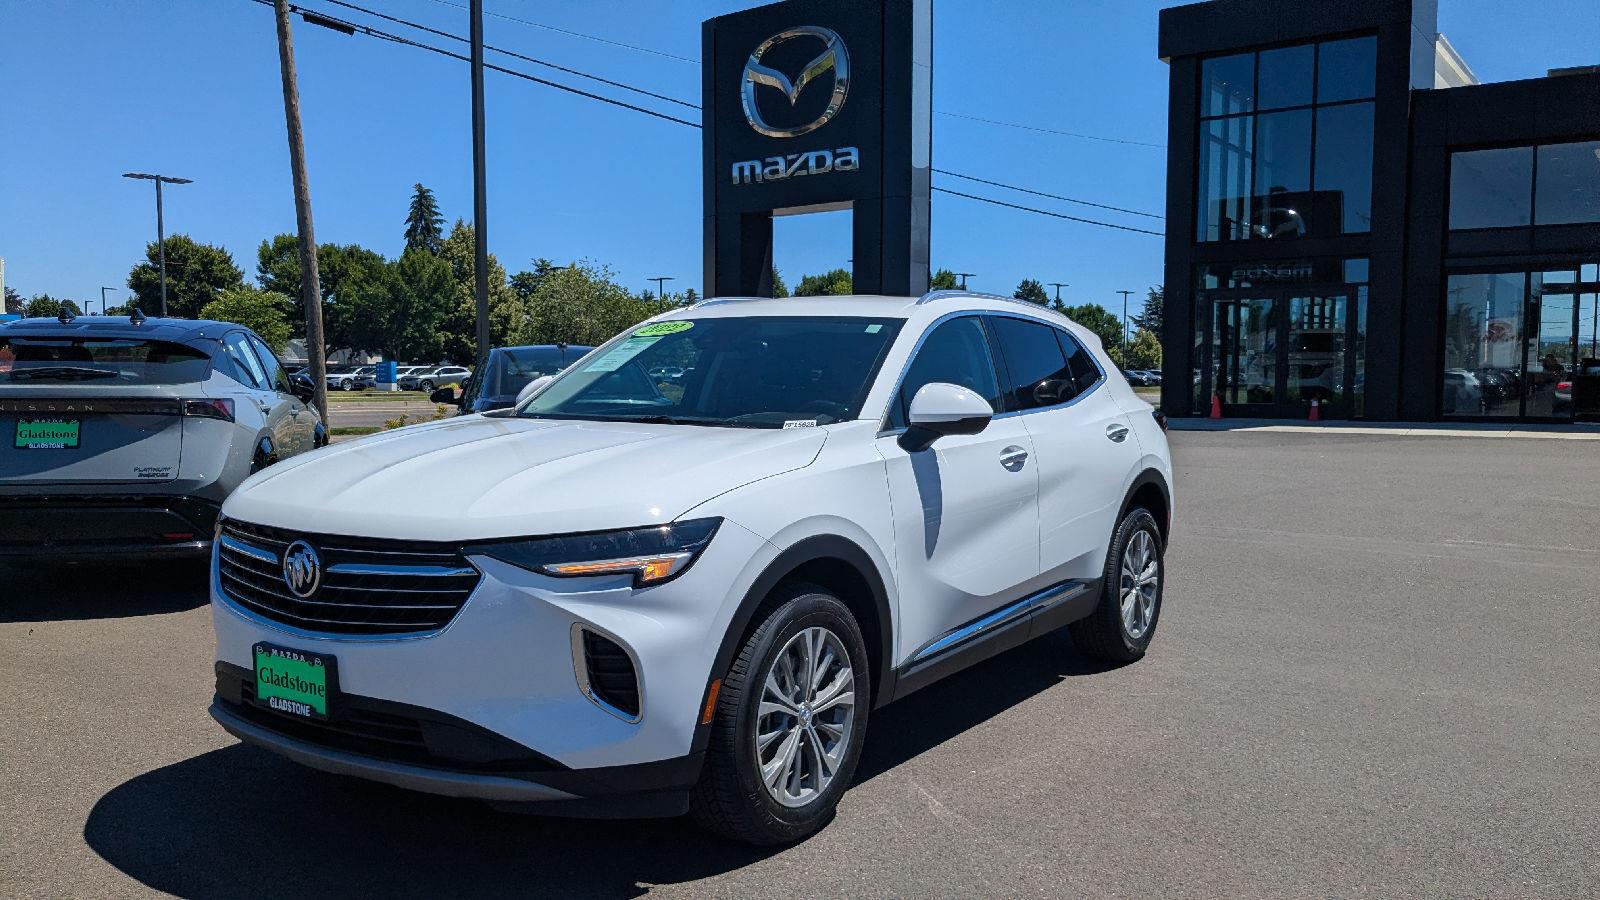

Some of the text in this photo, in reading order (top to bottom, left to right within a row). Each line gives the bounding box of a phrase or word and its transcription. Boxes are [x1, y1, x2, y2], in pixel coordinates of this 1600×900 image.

[19, 429, 77, 439] Gladstone
[272, 648, 305, 662] MAZDA
[260, 666, 325, 697] Gladstone
[270, 696, 311, 716] GLADSTONE
